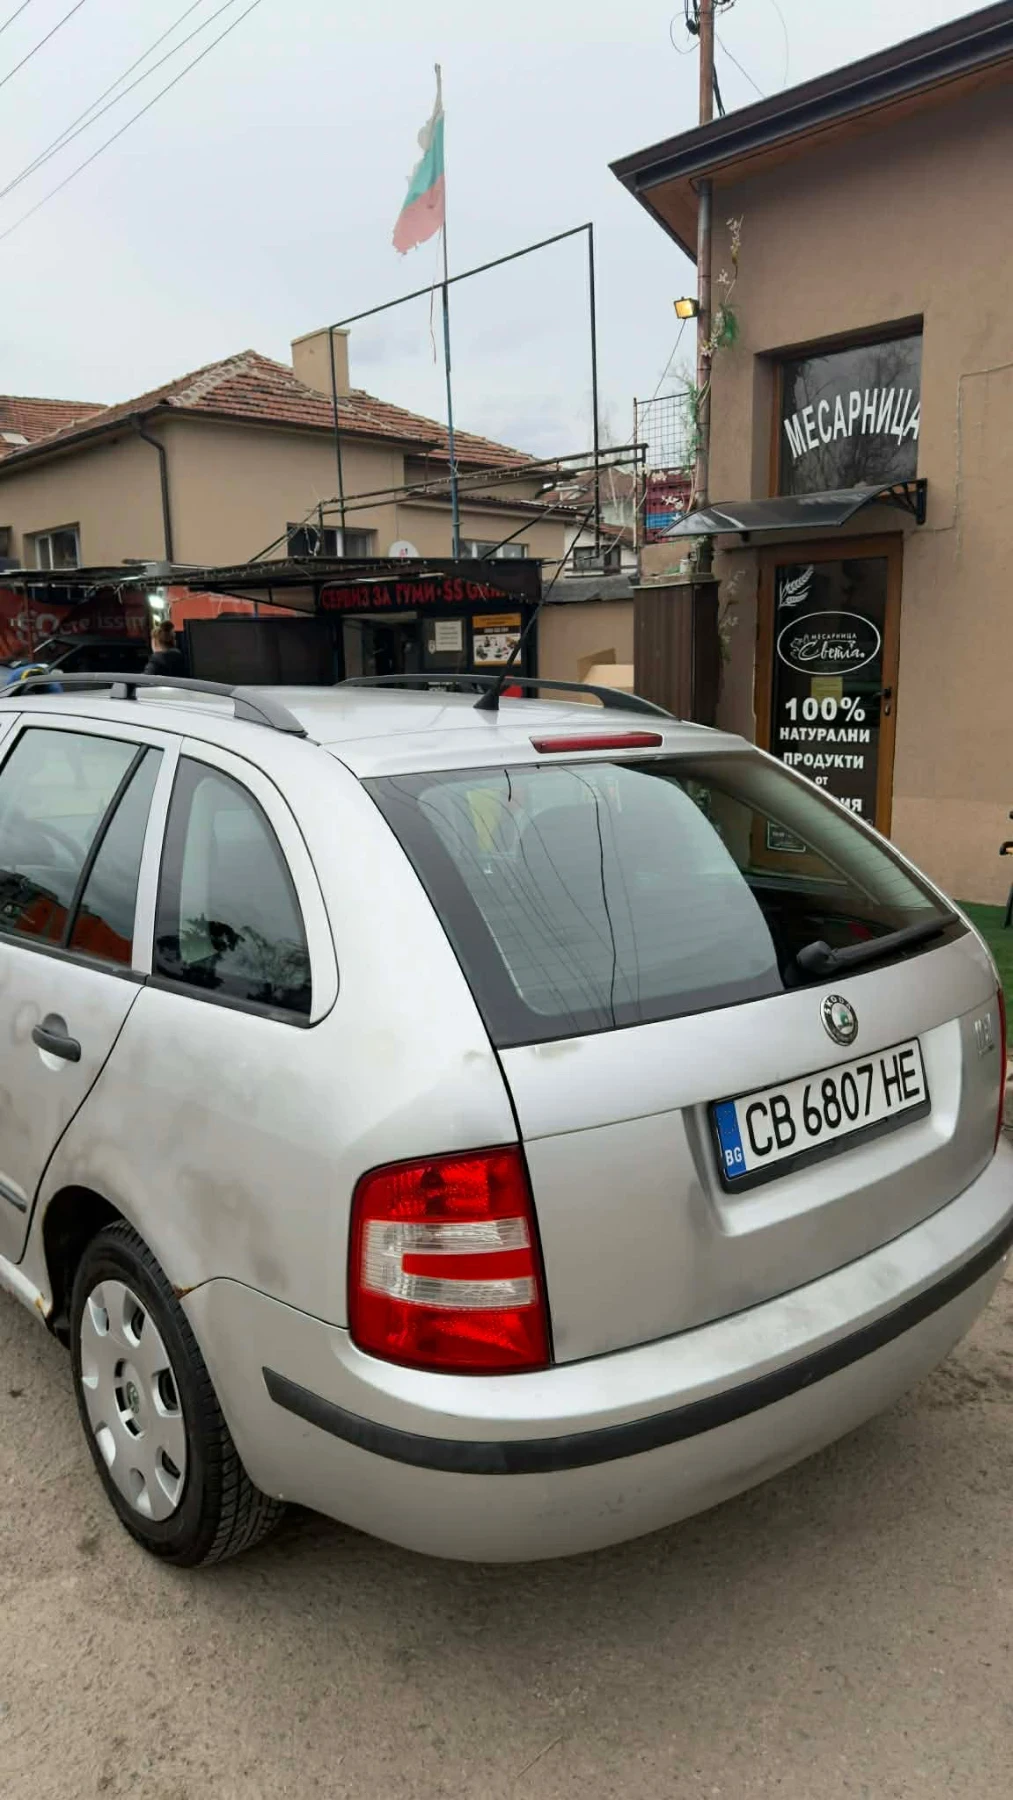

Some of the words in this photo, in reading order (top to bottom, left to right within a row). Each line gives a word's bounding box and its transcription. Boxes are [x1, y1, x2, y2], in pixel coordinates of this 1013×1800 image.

[784, 387, 921, 458] МЕСАРНИЦА
[372, 585, 392, 606] ЗА
[395, 581, 435, 605] ГУМИ
[811, 632, 857, 640] МЕСАРНИЦА
[785, 697, 866, 721] 100%
[780, 727, 870, 743] НАТУРАЛНИ
[783, 752, 864, 769] ПРОДУКТИ
[745, 1094, 796, 1156] CB
[803, 1063, 873, 1136] 6807
[880, 1049, 920, 1108] HE
[725, 1147, 743, 1165] BG
